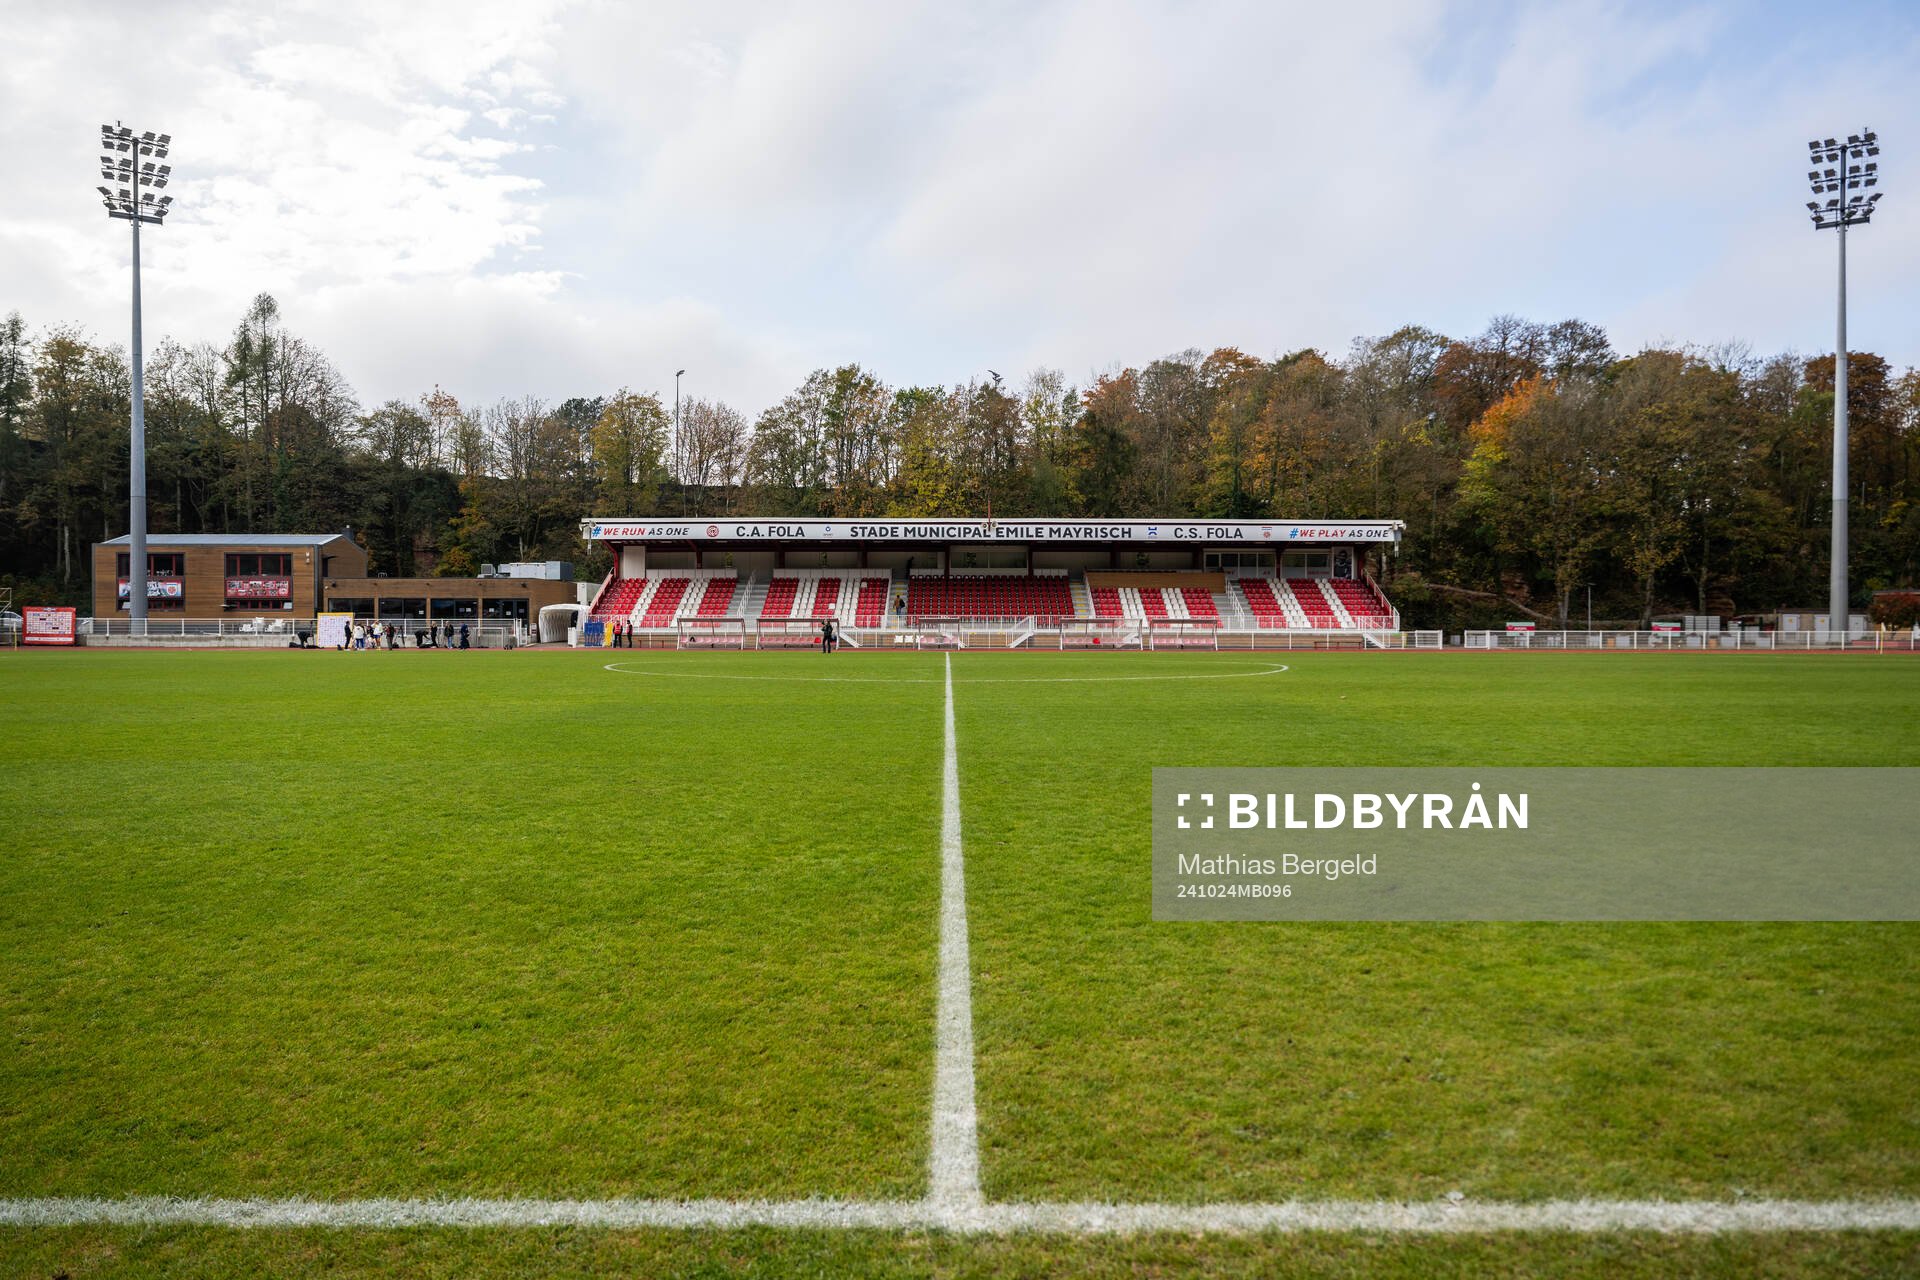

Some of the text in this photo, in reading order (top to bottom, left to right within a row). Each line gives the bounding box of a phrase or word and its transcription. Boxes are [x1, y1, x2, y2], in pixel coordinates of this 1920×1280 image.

[621, 527, 646, 536] RUN
[648, 527, 664, 536] AS
[666, 527, 690, 536] ONE
[735, 525, 806, 537] C.A. FOLA
[850, 526, 1132, 539] STADE MUNICIPAL EMILE MAYRISCH
[1173, 527, 1244, 539] C.S. FOLA
[1318, 529, 1347, 538] PLAY
[1348, 529, 1364, 538] AS
[1366, 529, 1389, 538] ONE
